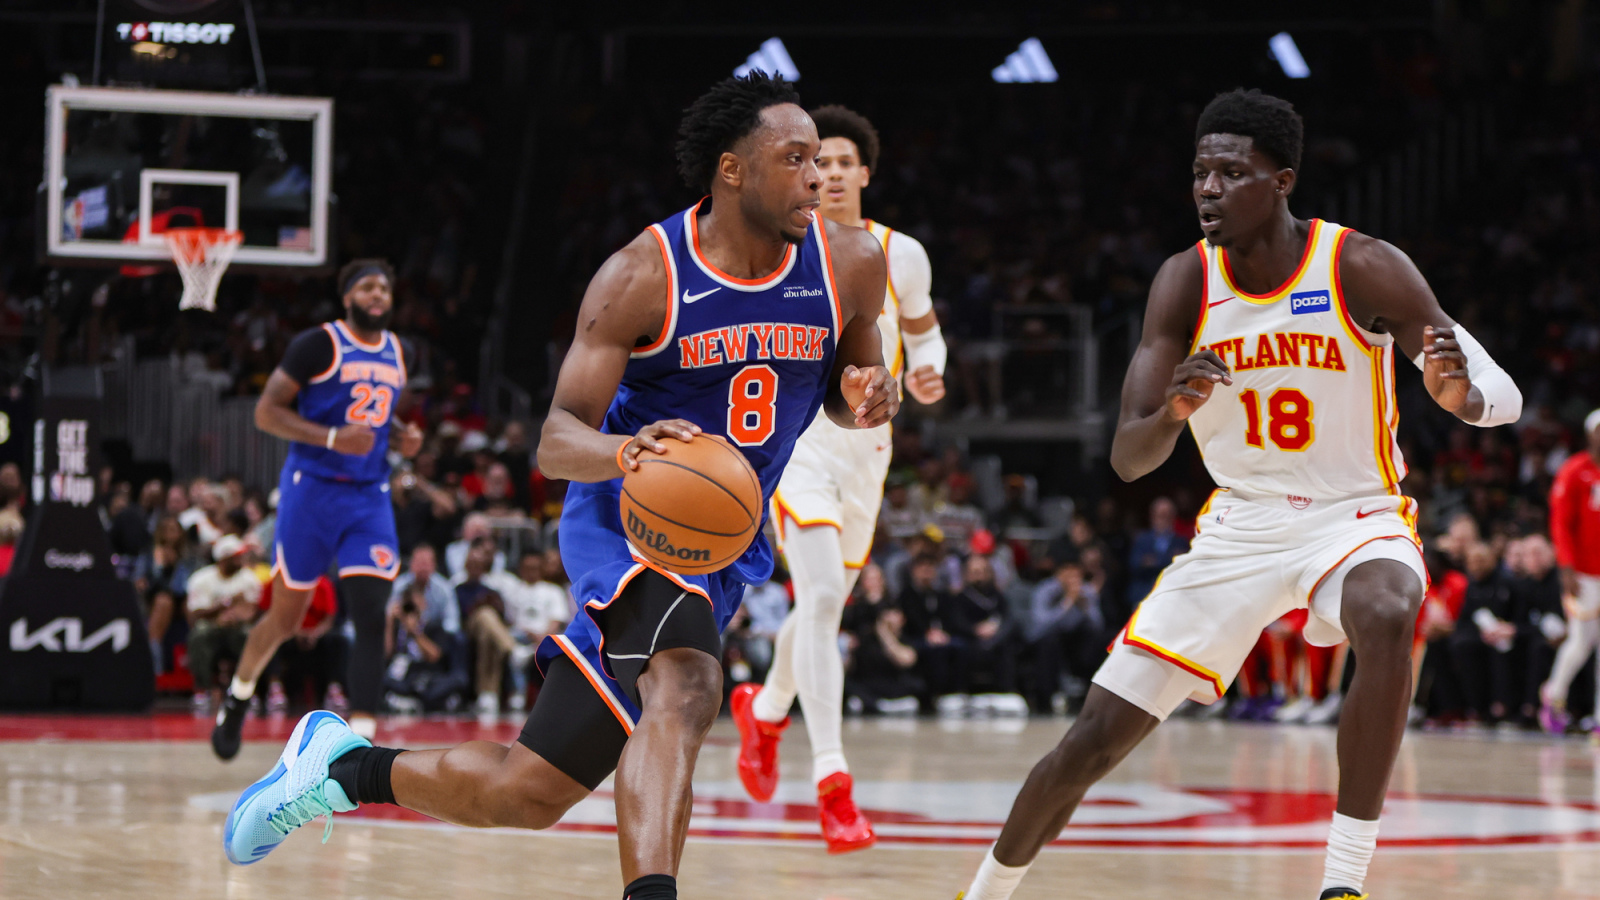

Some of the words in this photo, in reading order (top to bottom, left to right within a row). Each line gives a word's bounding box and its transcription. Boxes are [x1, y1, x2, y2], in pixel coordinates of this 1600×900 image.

[783, 290, 799, 298] abu
[800, 288, 823, 297] dhabi
[1292, 294, 1328, 311] paze
[678, 324, 750, 369] NEW
[750, 322, 829, 361] YORK
[1200, 331, 1347, 373] TLANTA
[345, 382, 393, 427] 23
[727, 364, 779, 447] 8
[1238, 387, 1316, 452] 18
[627, 508, 711, 561] Wilson
